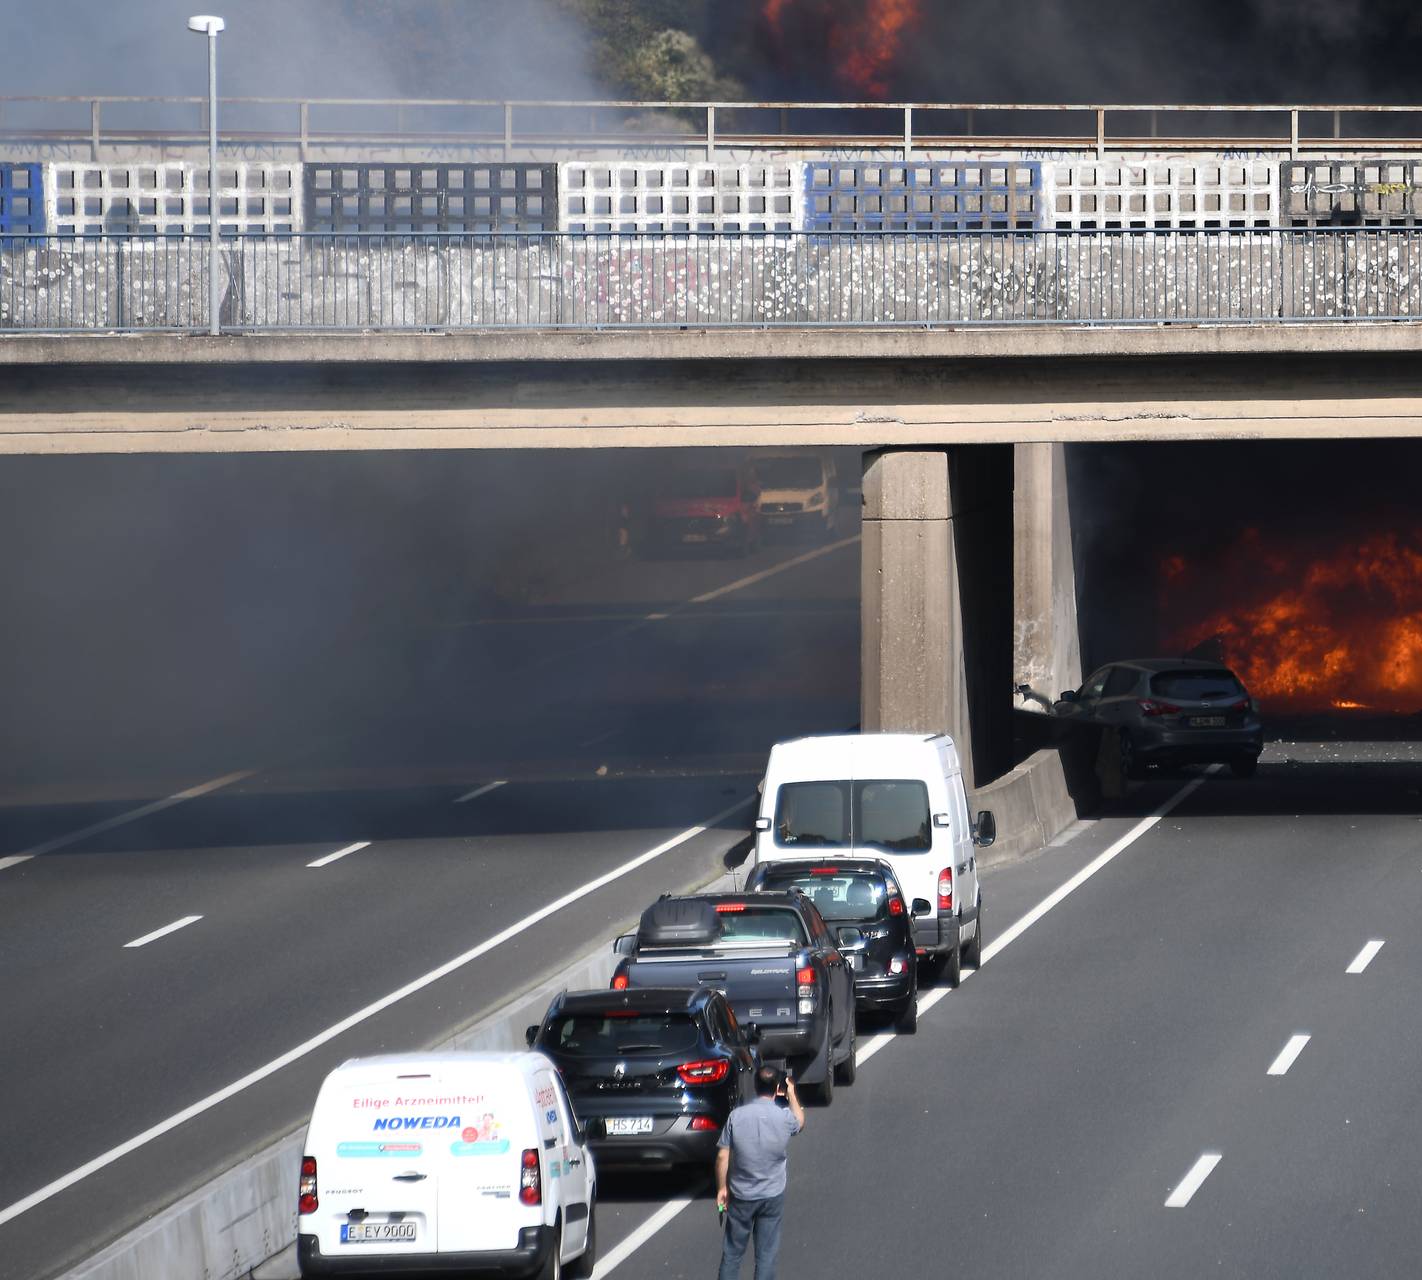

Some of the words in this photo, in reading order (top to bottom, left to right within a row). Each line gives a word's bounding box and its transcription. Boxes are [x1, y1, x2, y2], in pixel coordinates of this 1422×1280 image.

[352, 1097, 390, 1110] Eilige
[373, 1116, 461, 1131] NOWEDA
[630, 1118, 650, 1130] 714
[349, 1226, 356, 1239] E
[365, 1225, 381, 1238] EY
[384, 1224, 414, 1238] 9000
